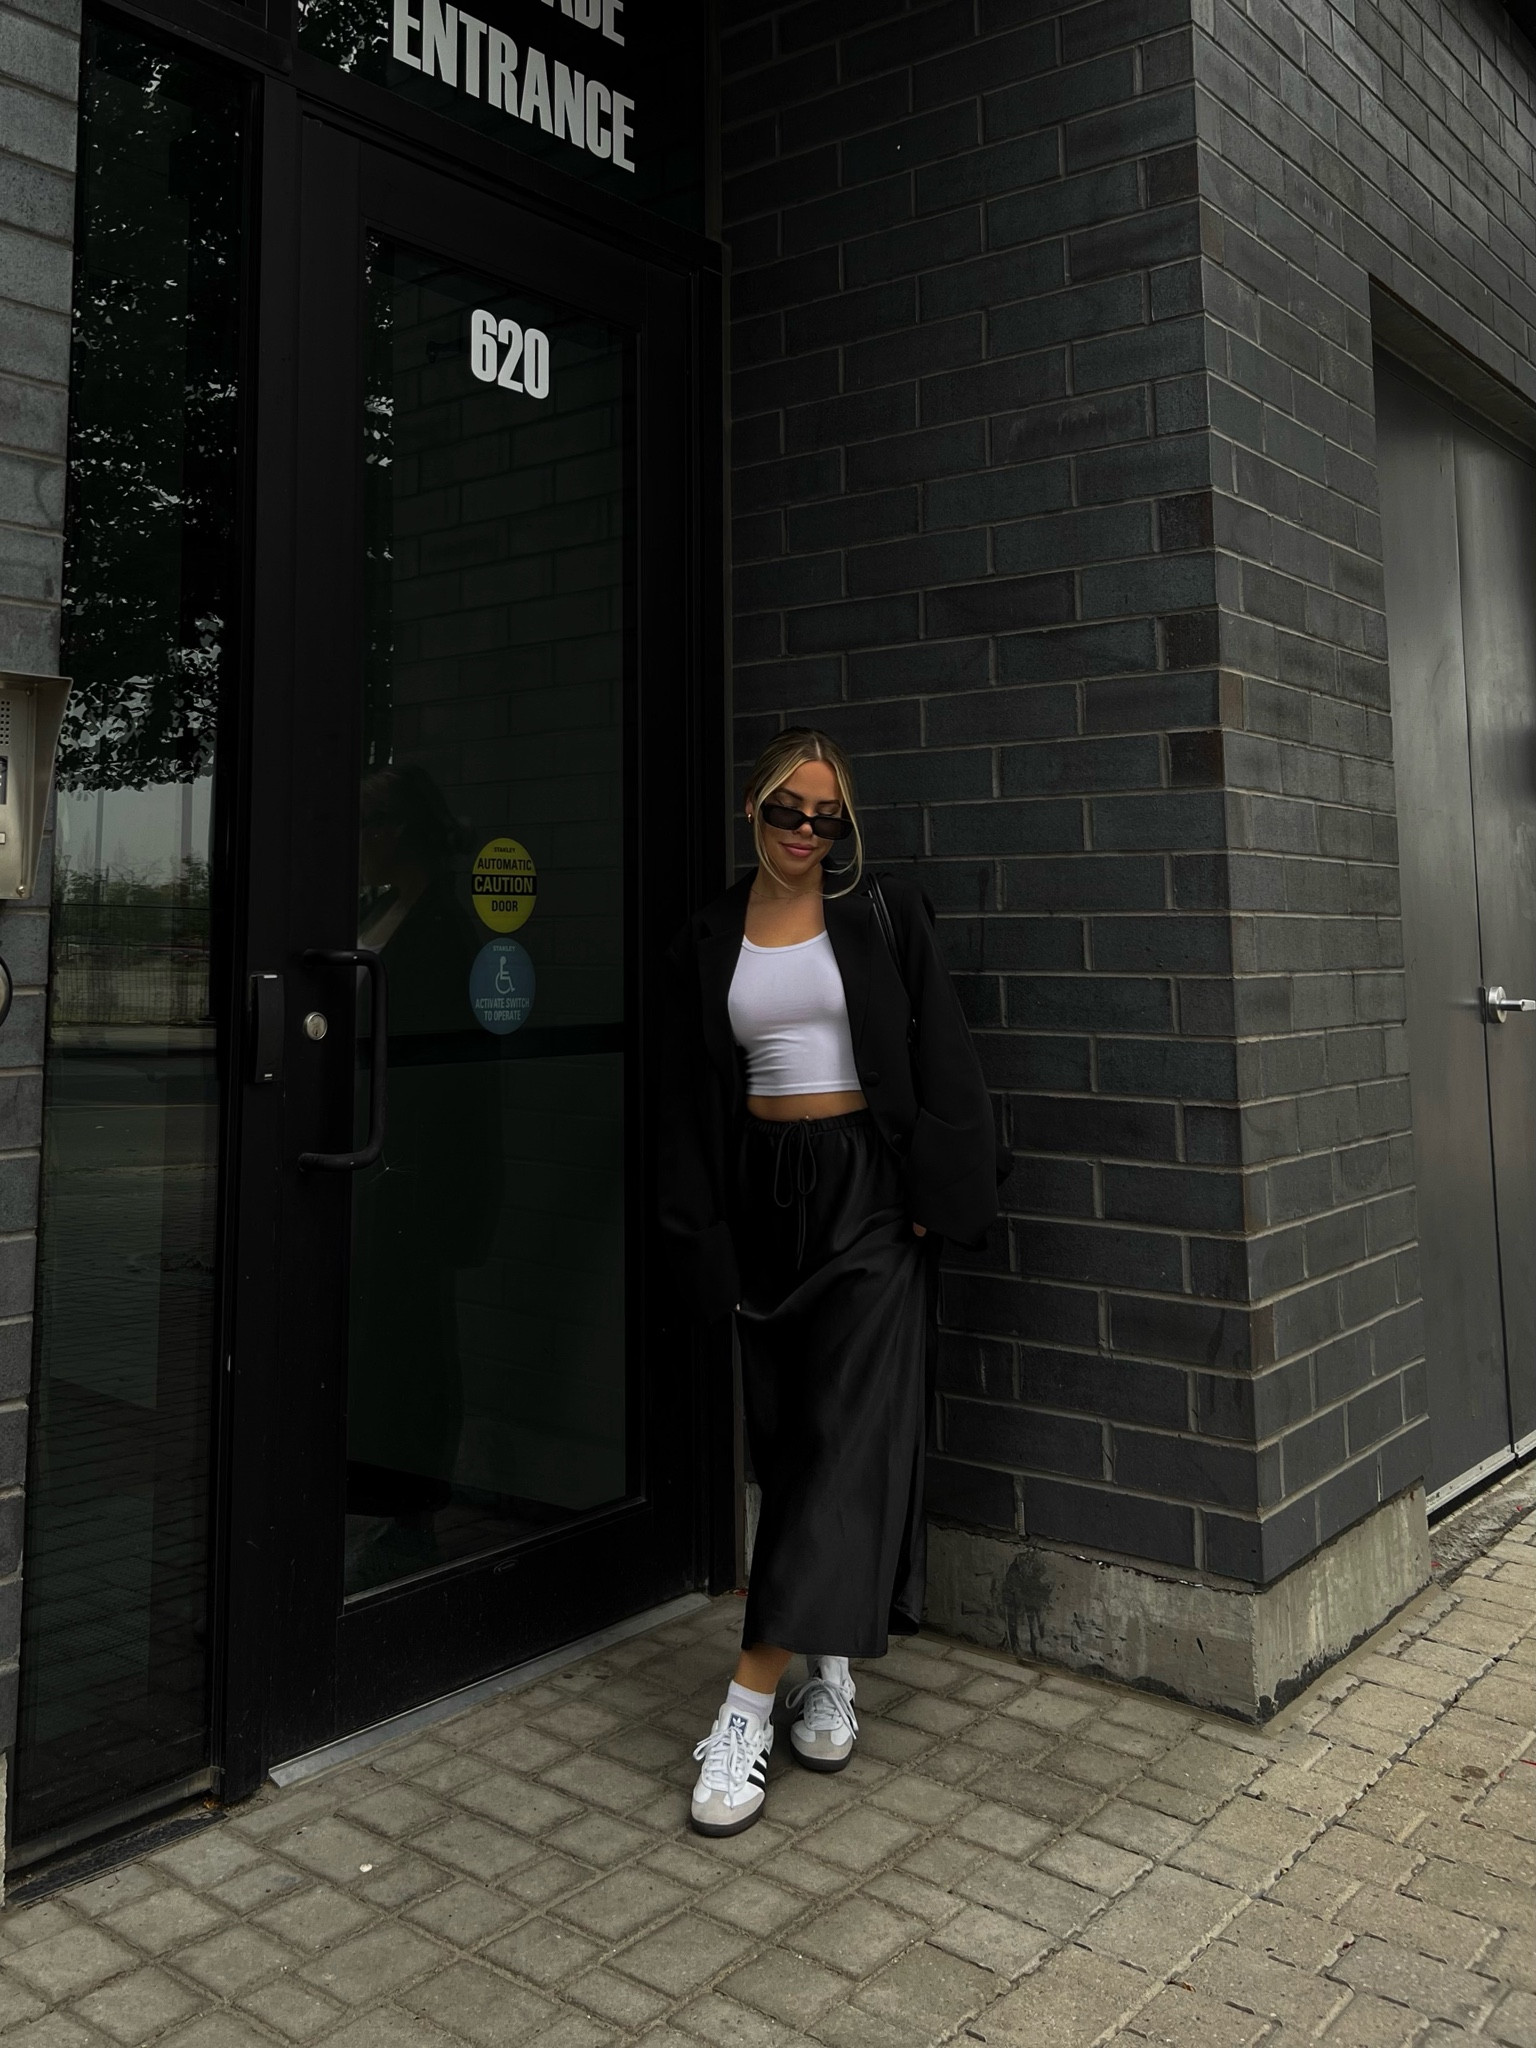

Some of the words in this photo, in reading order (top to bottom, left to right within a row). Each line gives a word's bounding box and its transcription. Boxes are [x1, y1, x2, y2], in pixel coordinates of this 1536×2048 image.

[392, 0, 636, 174] ENTRANCE
[471, 308, 549, 399] 620
[494, 846, 516, 854] STANLEY
[477, 858, 532, 871] AUTOMATIC
[474, 876, 533, 893] CAUTION
[491, 900, 518, 912] DOOR
[475, 998, 504, 1009] ACTIVATE
[506, 997, 530, 1008] SWITCH
[484, 1010, 493, 1021] TO
[493, 1010, 521, 1021] OPERATE
